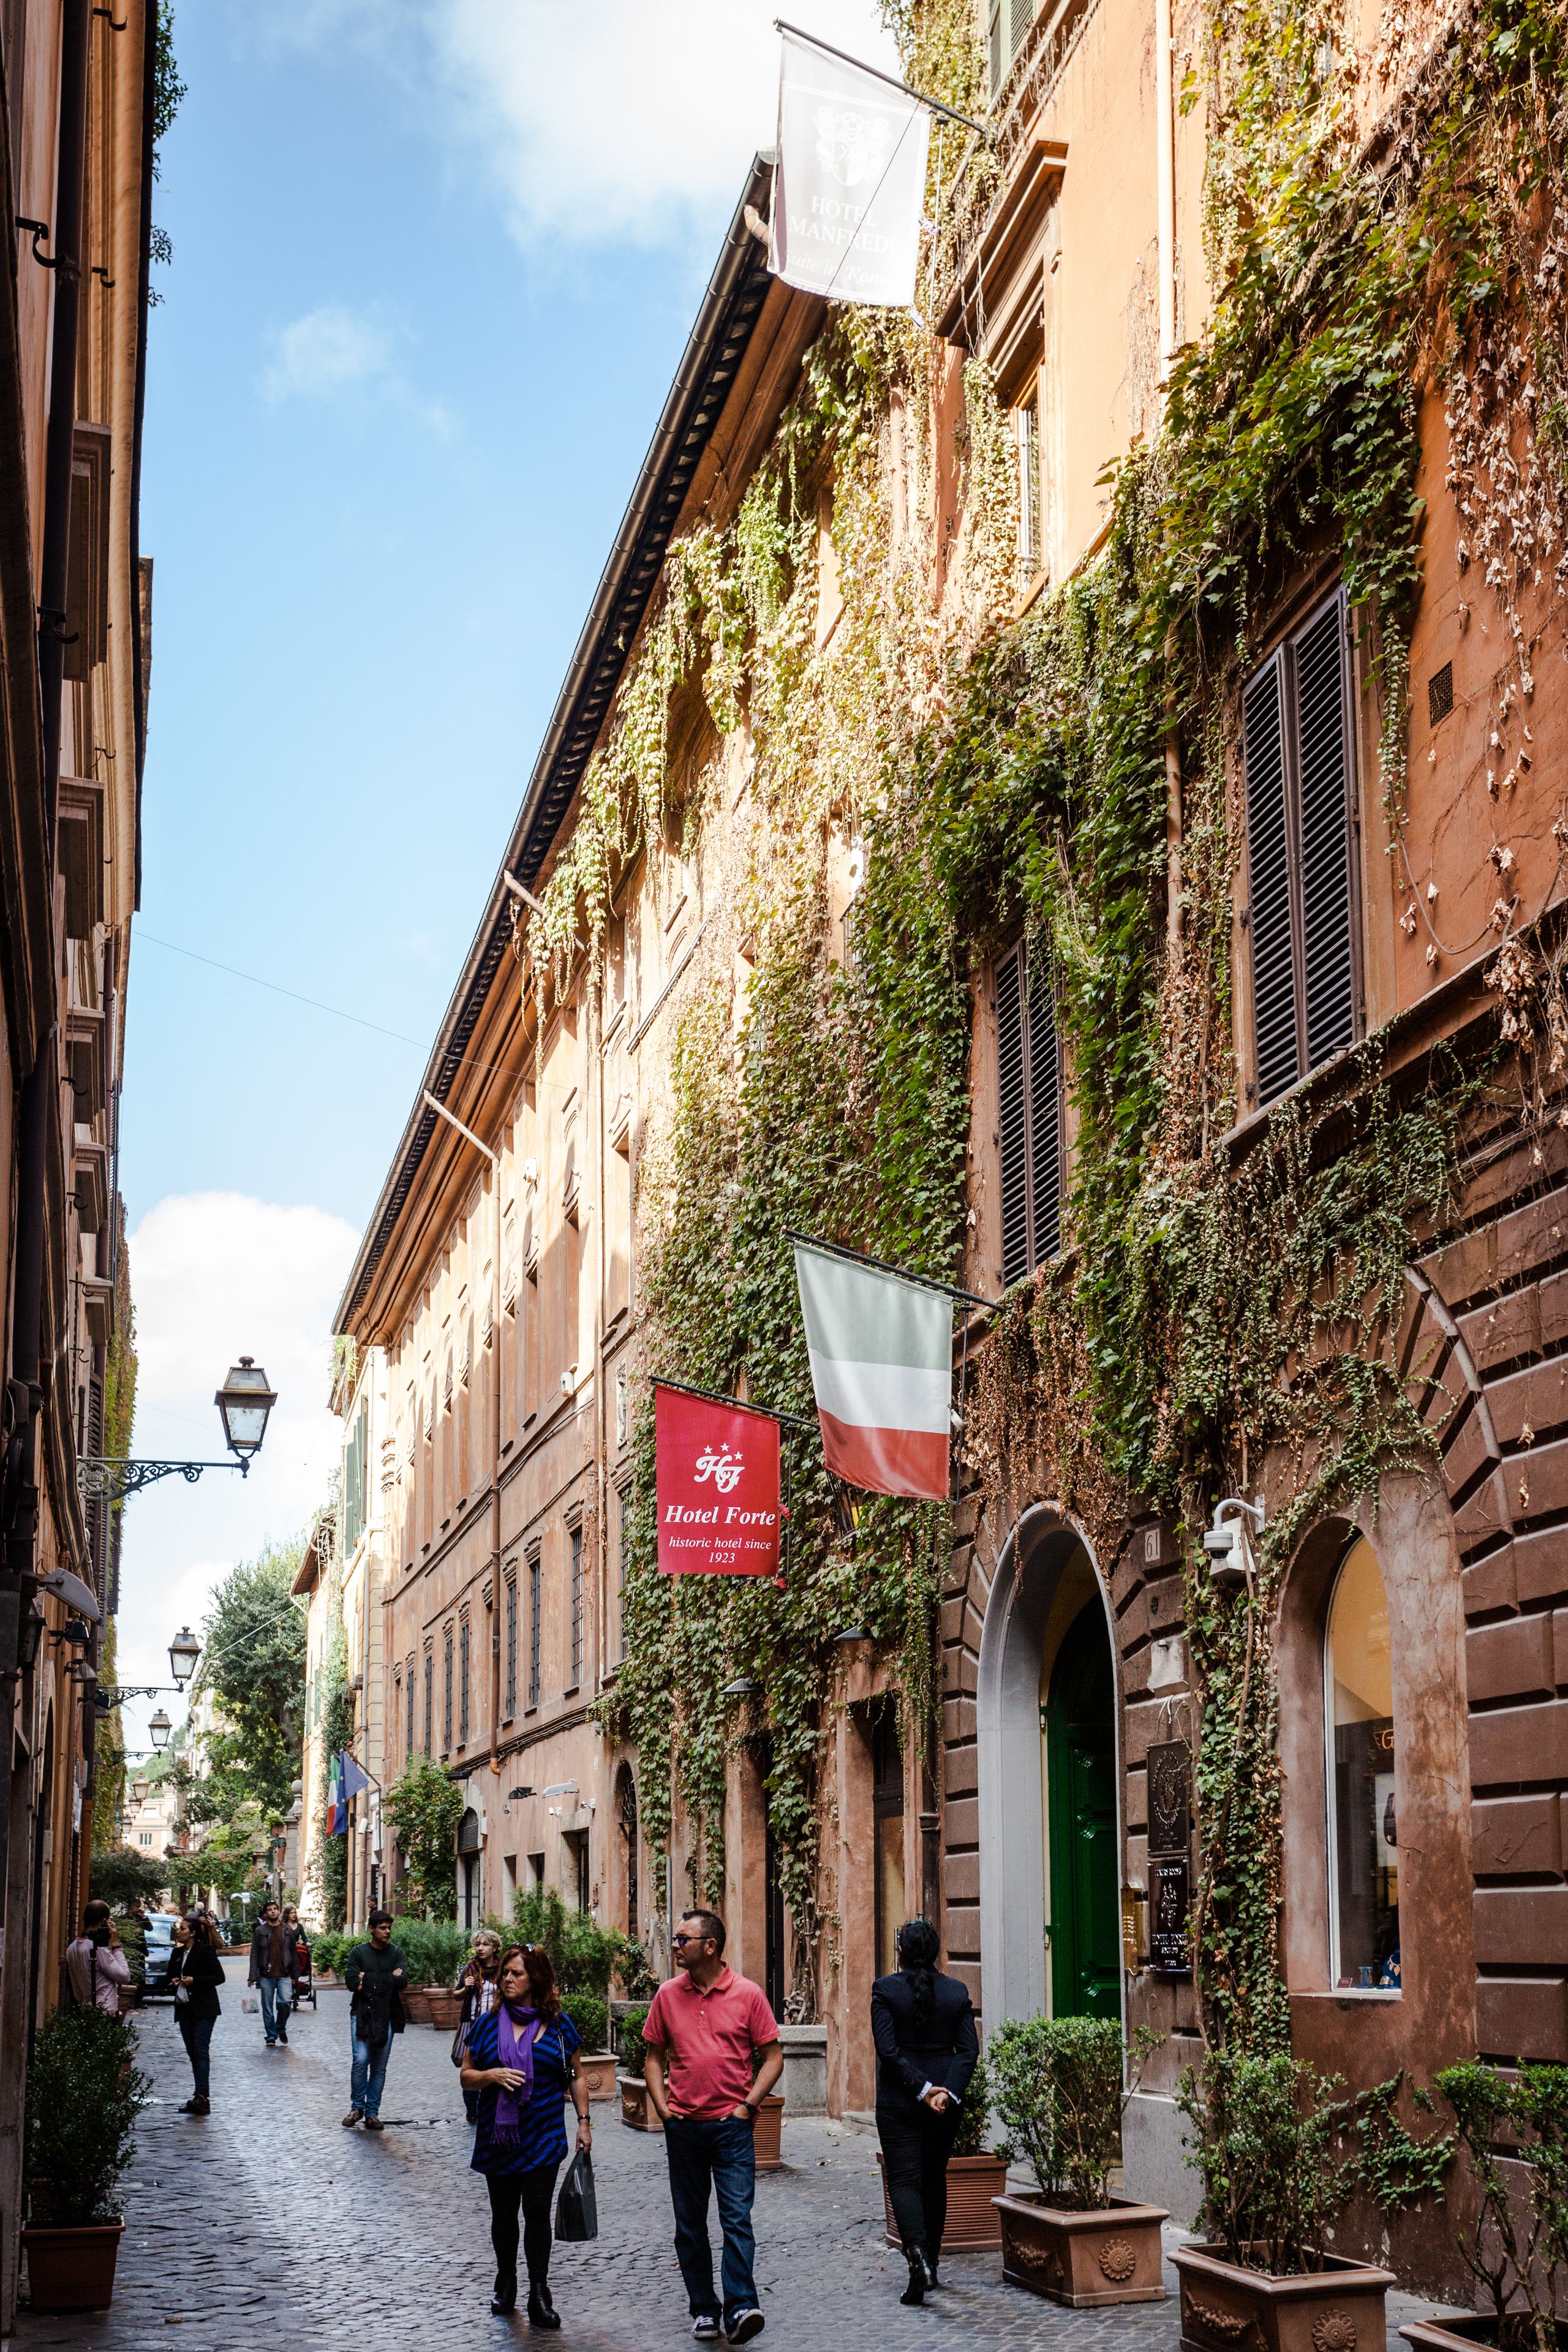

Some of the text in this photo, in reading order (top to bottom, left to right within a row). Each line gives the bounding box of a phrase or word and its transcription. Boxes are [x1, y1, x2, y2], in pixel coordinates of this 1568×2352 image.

[810, 195, 878, 226] HOTEL
[663, 1505, 776, 1526] Hotel Forte
[668, 1536, 772, 1550] historic hotel since
[1146, 1532, 1158, 1558] 61
[708, 1551, 735, 1564] 1923
